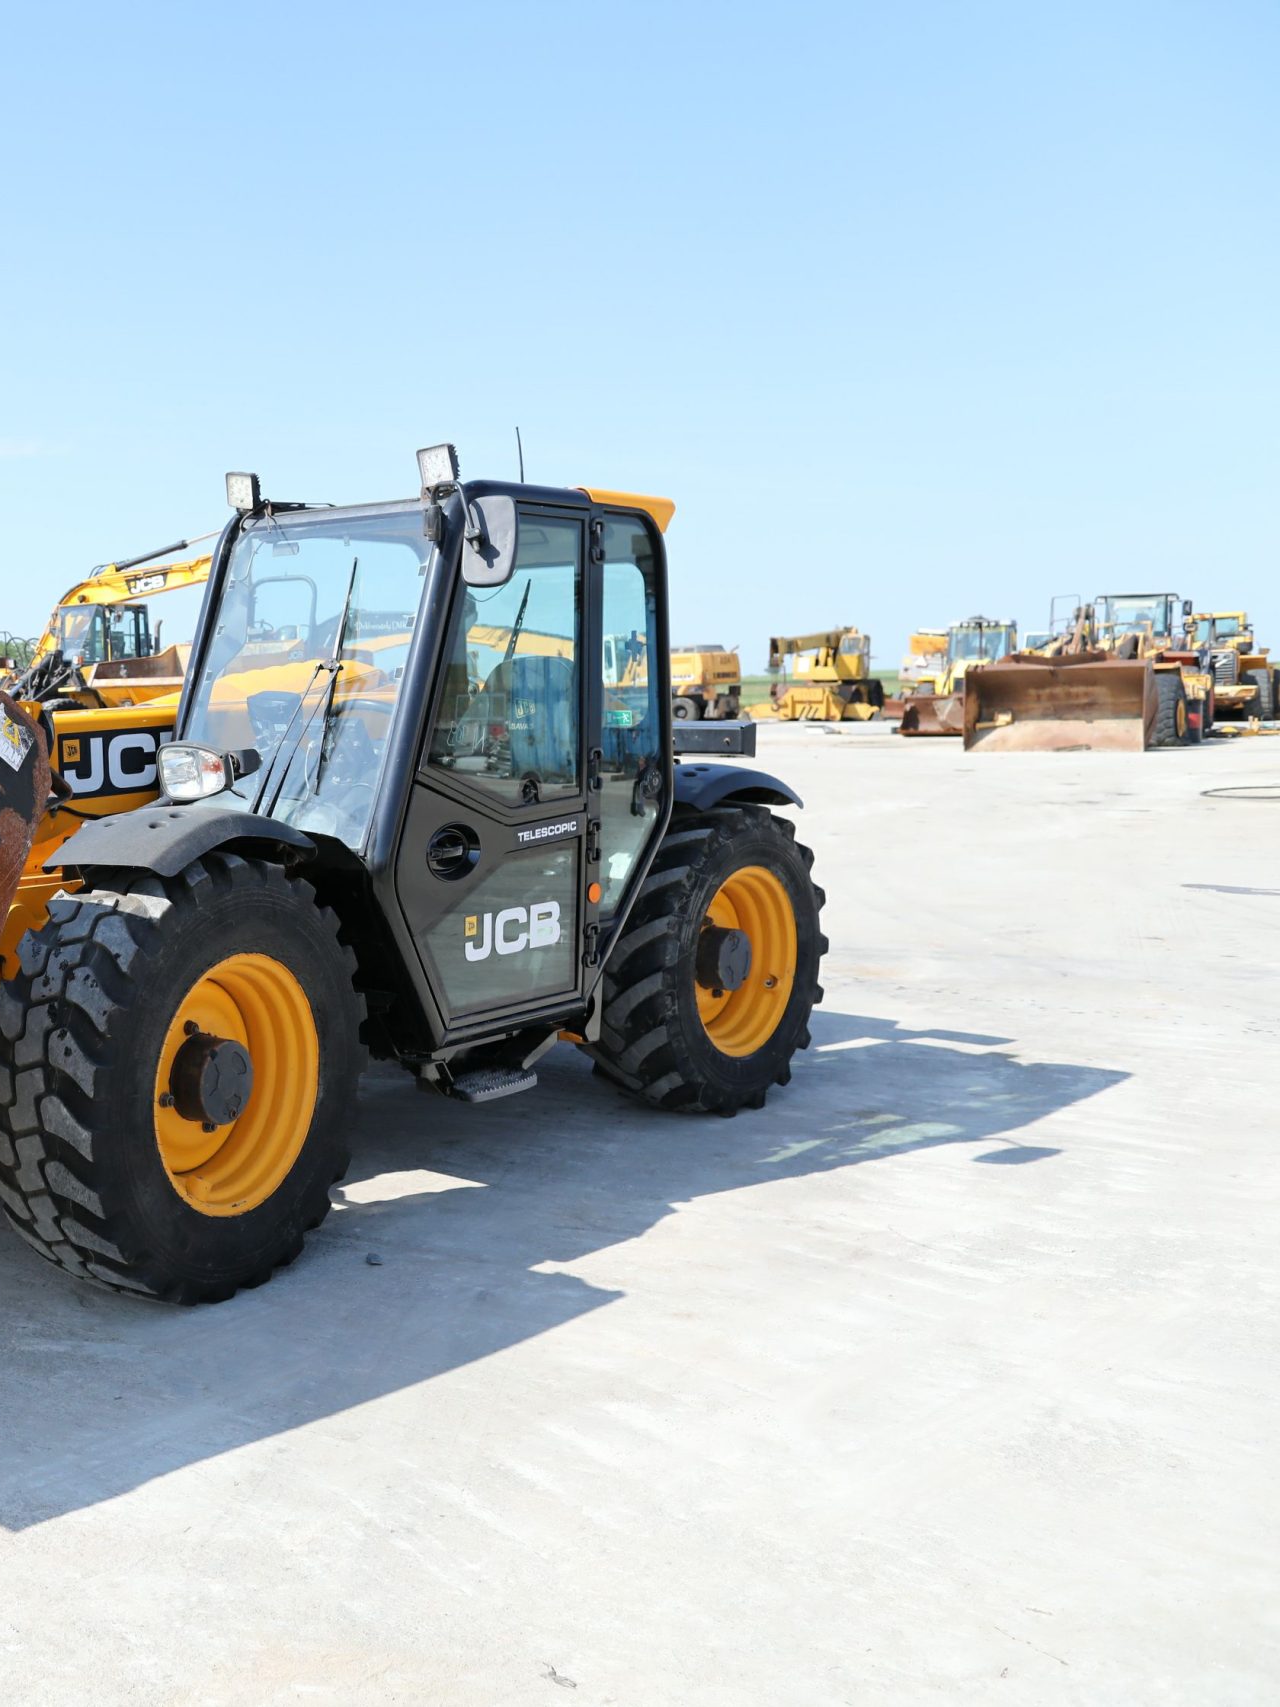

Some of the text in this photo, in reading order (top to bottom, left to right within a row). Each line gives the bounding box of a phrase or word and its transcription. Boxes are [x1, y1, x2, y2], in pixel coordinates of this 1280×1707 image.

[130, 575, 165, 594] JCB
[63, 731, 173, 793] JC
[518, 821, 577, 842] TELESCOPIC
[465, 901, 561, 962] JCB
